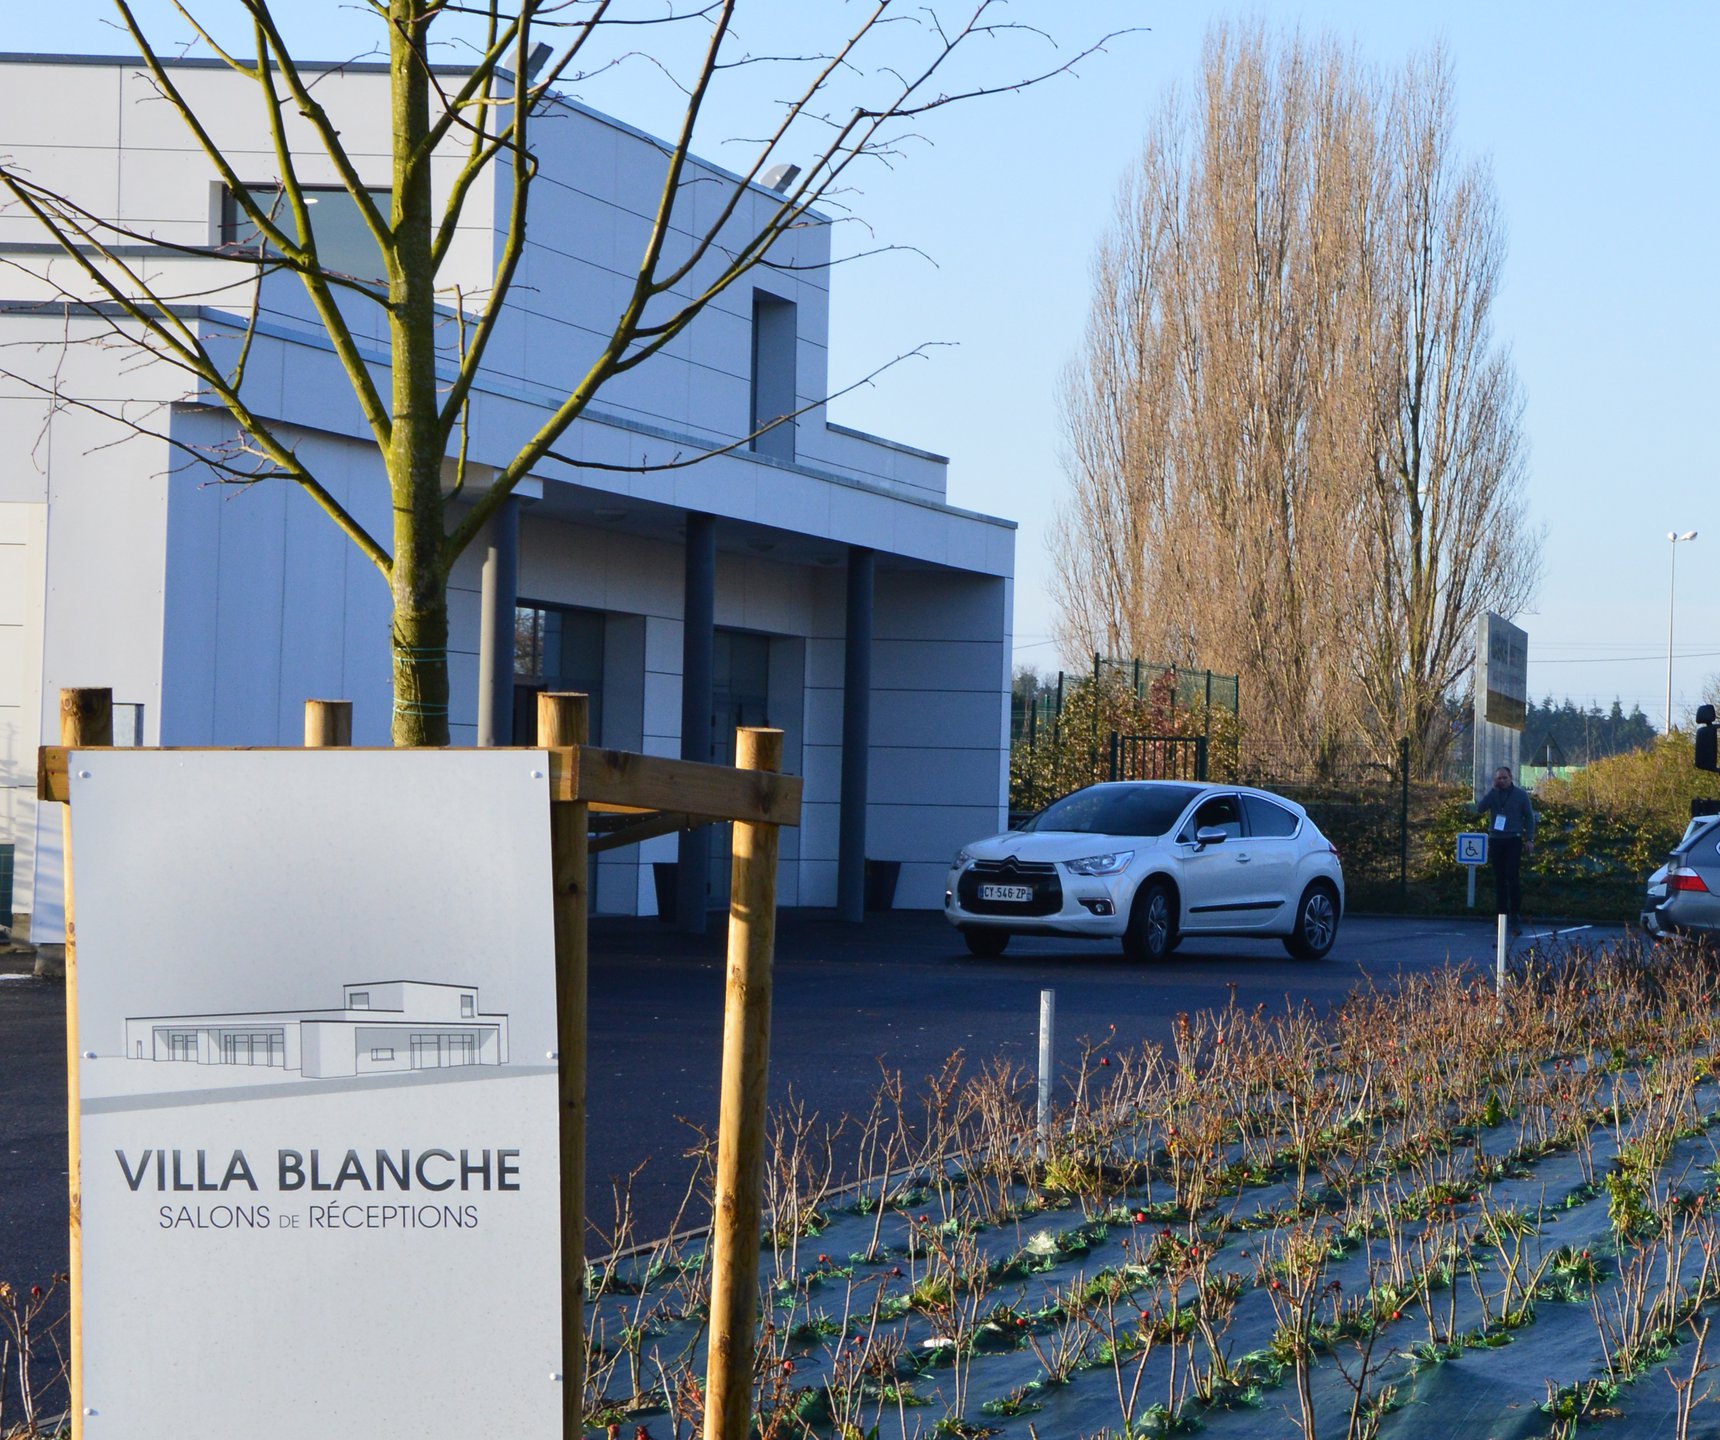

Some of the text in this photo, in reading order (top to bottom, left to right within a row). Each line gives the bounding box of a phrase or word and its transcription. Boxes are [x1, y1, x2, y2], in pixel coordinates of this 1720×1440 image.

[114, 1148, 521, 1192] VILLA BLANCHE
[159, 1200, 479, 1229] SALONS DE RÉCEPTIONS
